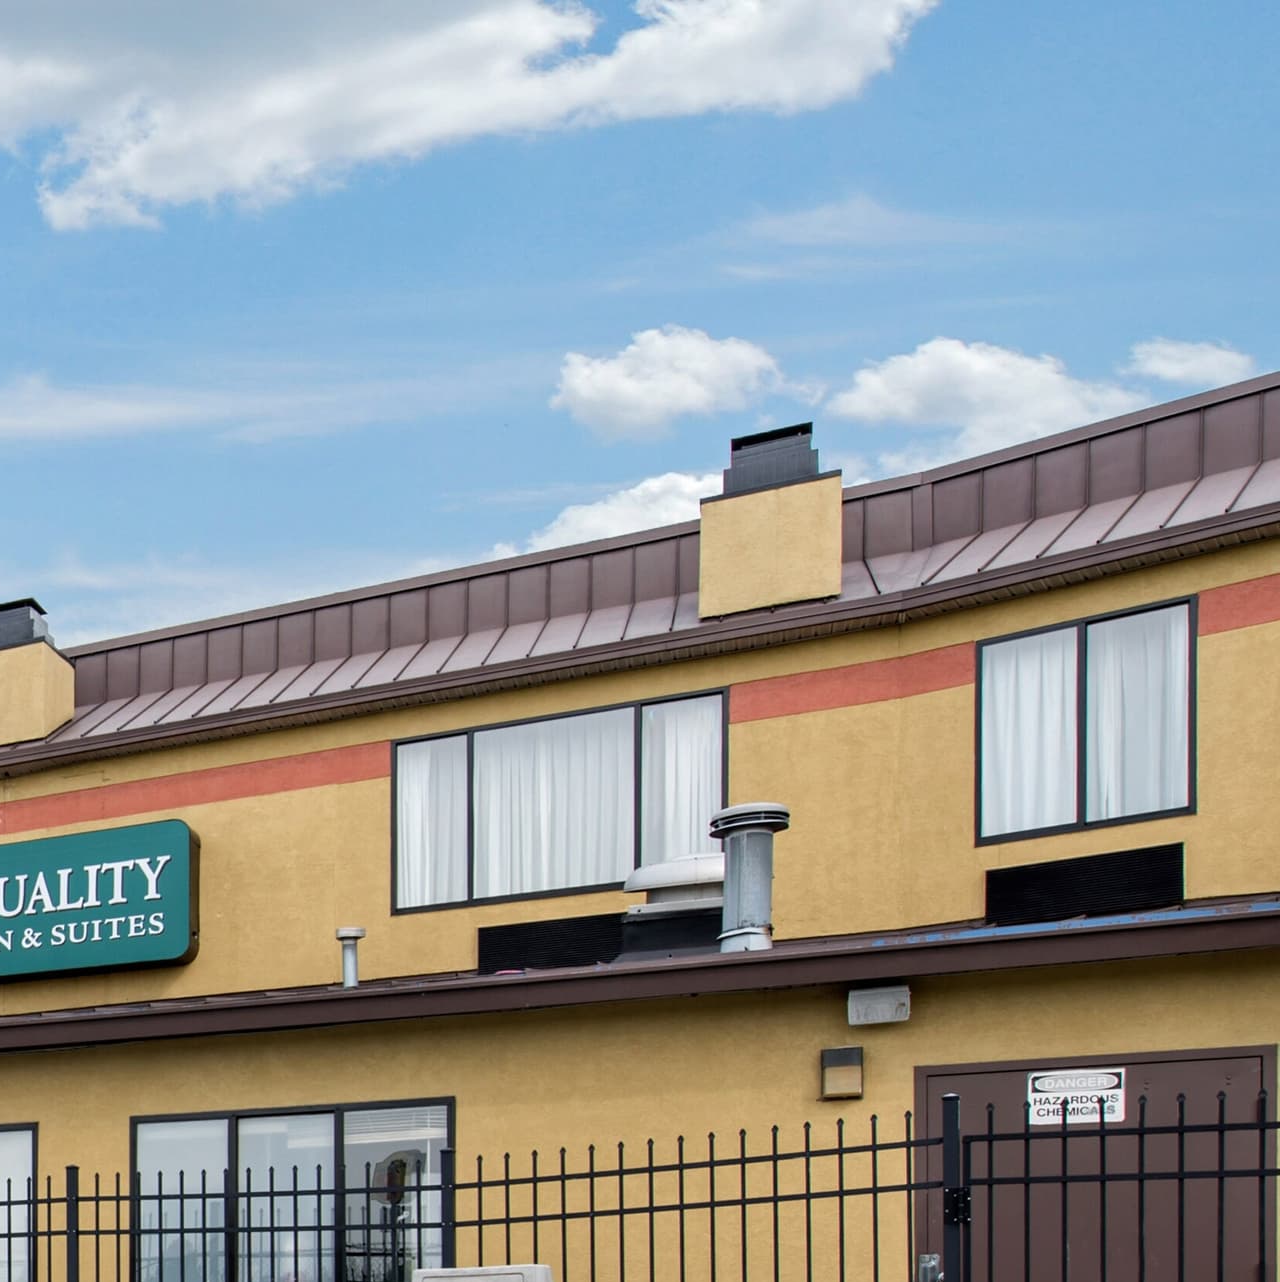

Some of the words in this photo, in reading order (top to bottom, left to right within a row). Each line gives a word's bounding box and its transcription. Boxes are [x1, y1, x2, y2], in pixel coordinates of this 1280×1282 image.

[21, 928, 42, 949] &
[50, 912, 165, 946] SUITES
[1044, 1077, 1108, 1090] DANGER
[1036, 1104, 1116, 1117] CHEMICAS
